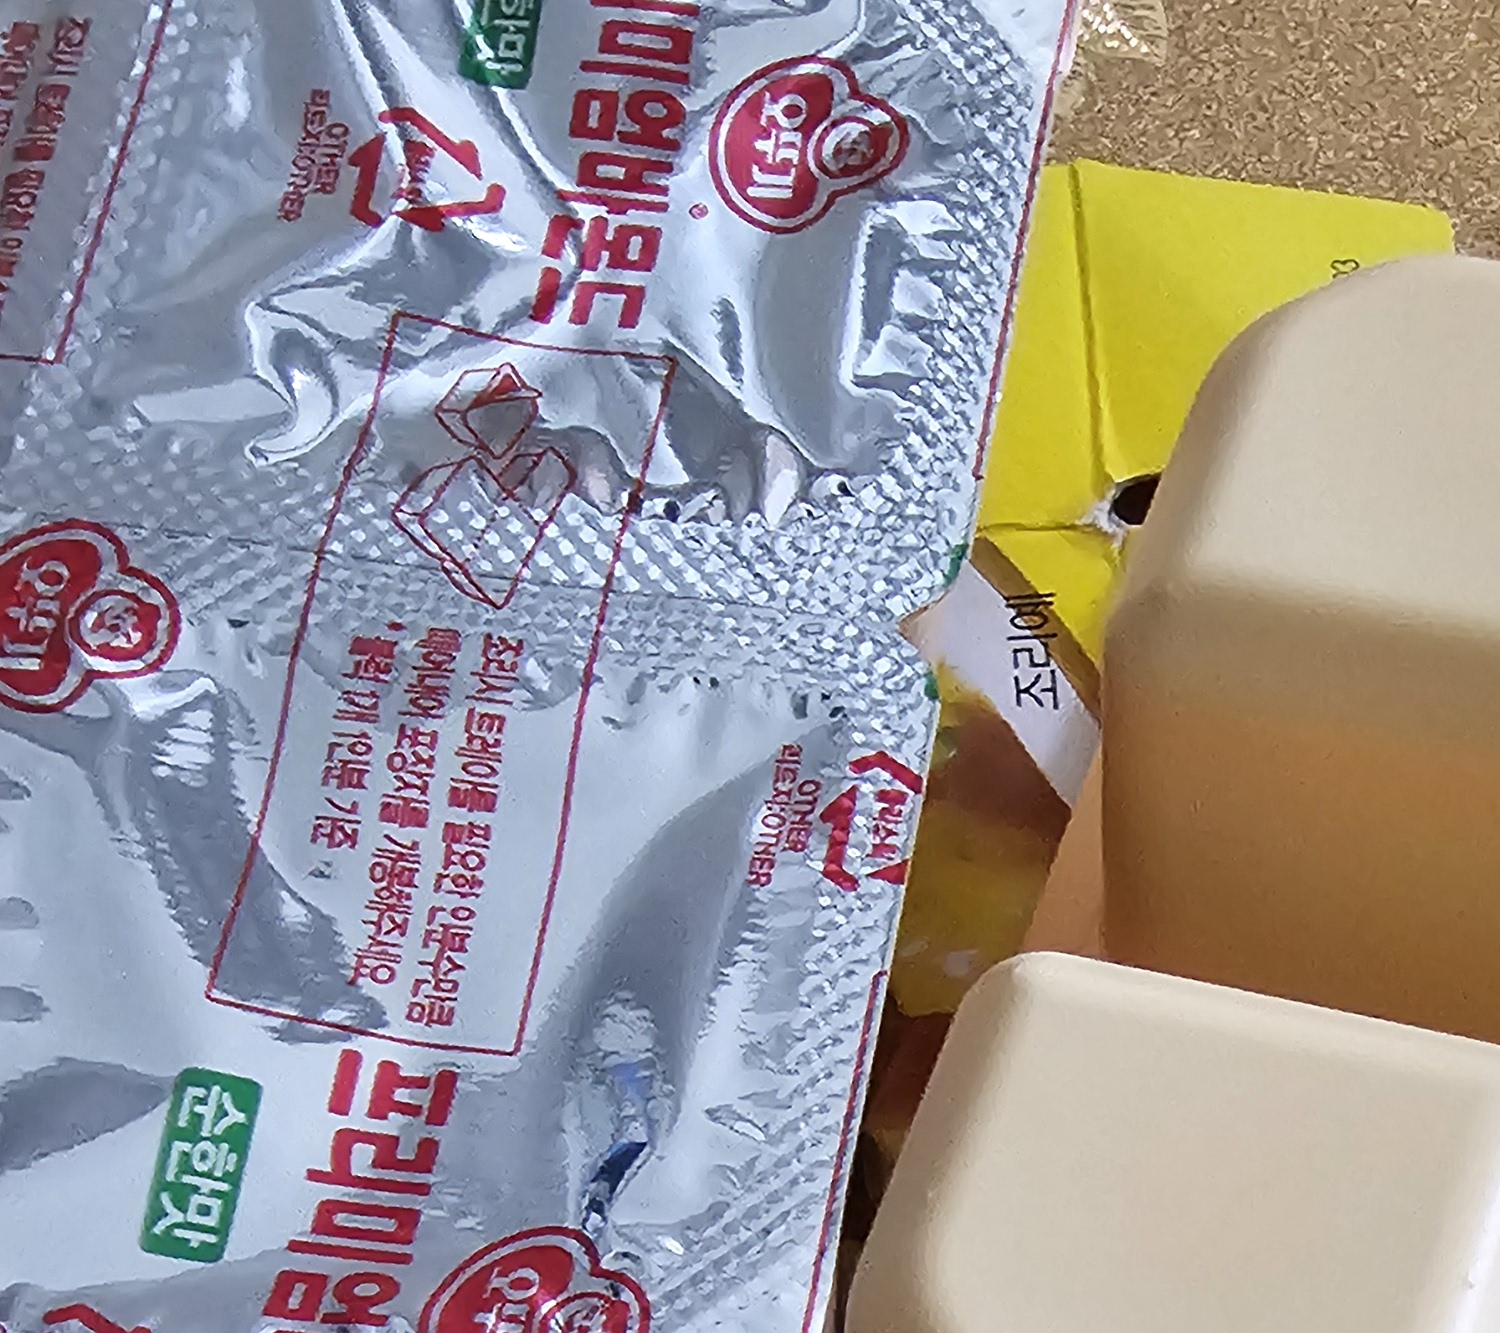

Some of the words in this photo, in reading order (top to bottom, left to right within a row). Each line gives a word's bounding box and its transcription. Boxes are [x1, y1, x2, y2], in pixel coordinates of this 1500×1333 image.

[530, 0, 697, 328] 미엄바몬드
[465, 633, 524, 705] 조리시
[1004, 591, 1058, 710] 조리예
[321, 731, 373, 791] 1인분
[378, 722, 439, 829] 포장지를
[447, 706, 507, 813] 트레이를
[310, 796, 362, 850] 기준
[432, 821, 492, 899] 필요한
[346, 834, 422, 986] 개봉해주세요
[405, 905, 478, 1028] 인분수만큼
[153, 1083, 247, 1247] 순한맛
